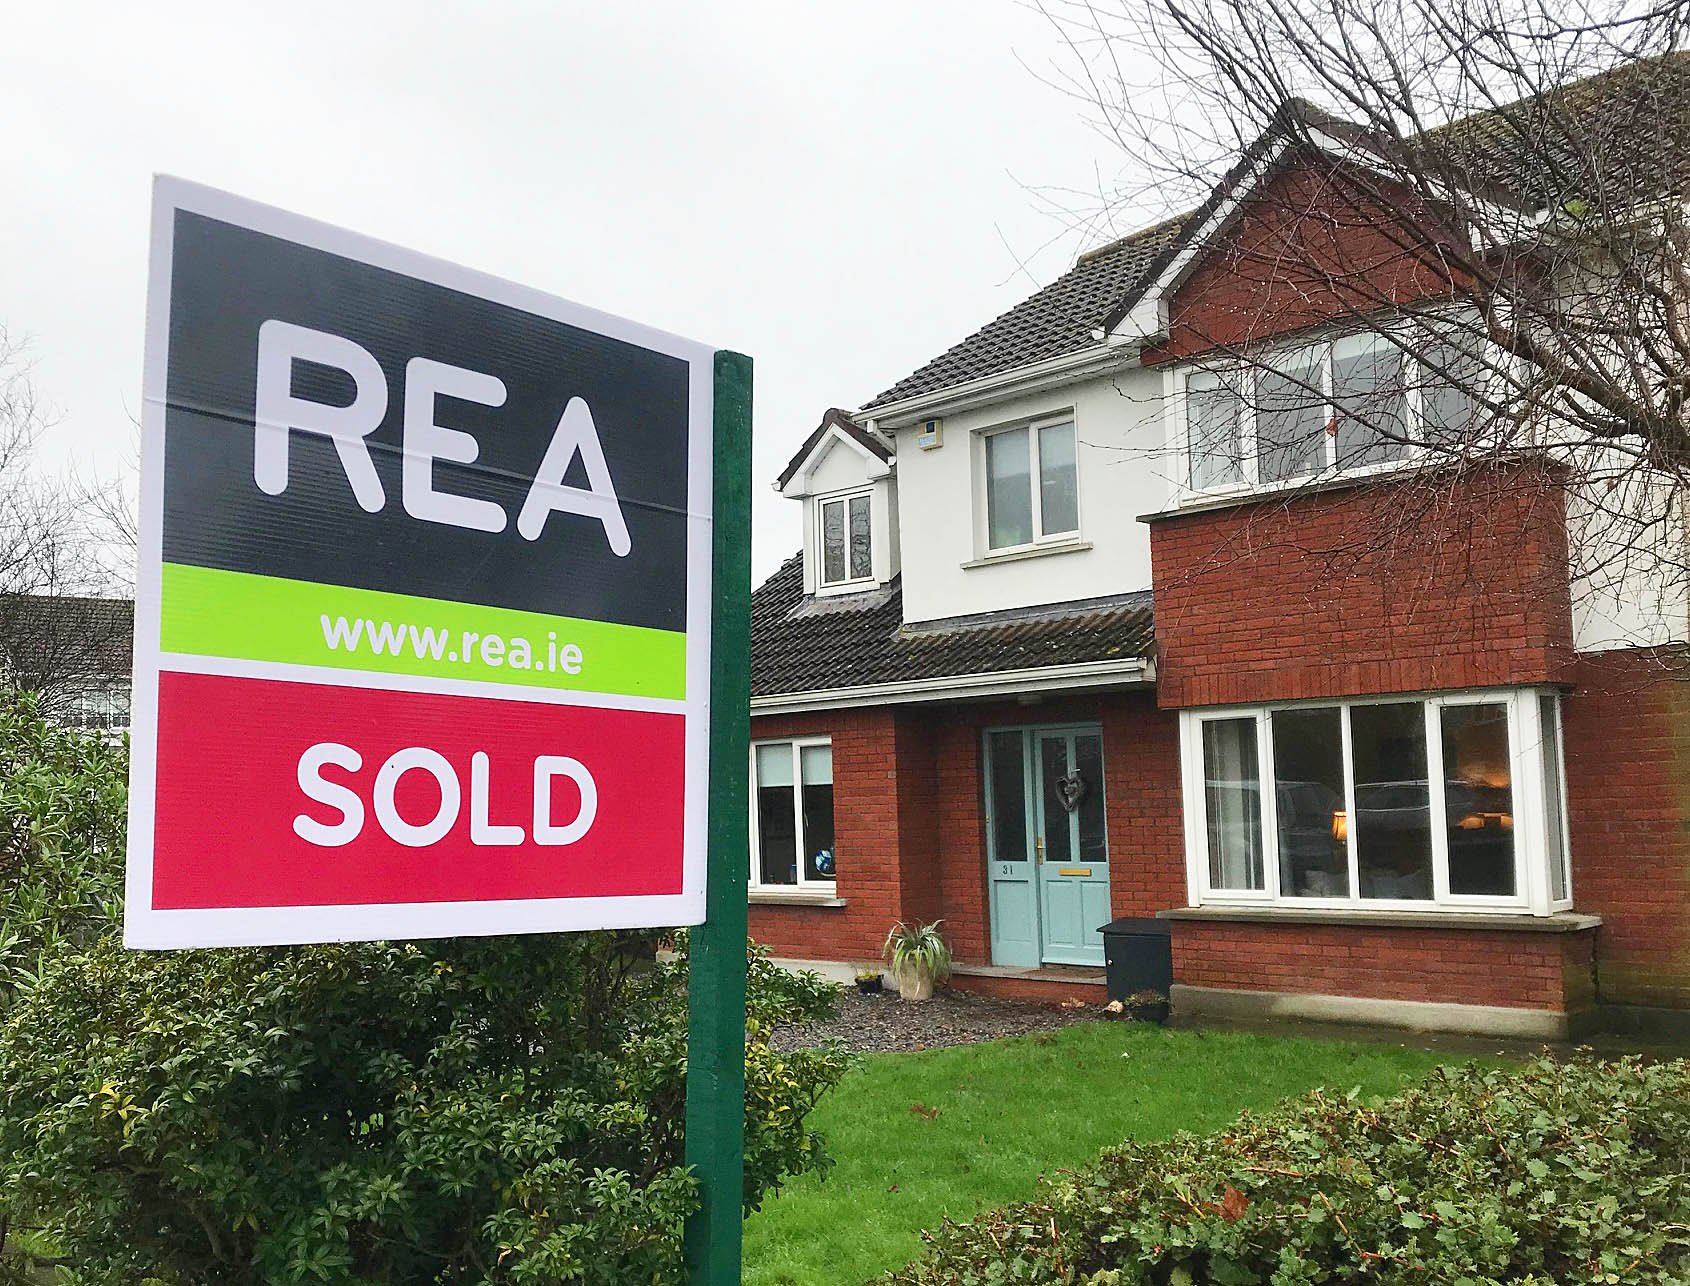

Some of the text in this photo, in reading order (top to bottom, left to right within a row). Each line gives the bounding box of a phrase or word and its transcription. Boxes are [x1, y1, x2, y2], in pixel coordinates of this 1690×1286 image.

[253, 319, 632, 558] REA
[320, 613, 584, 675] www.rea.ie
[292, 742, 599, 847] SOLD
[1002, 864, 1013, 875] 31
